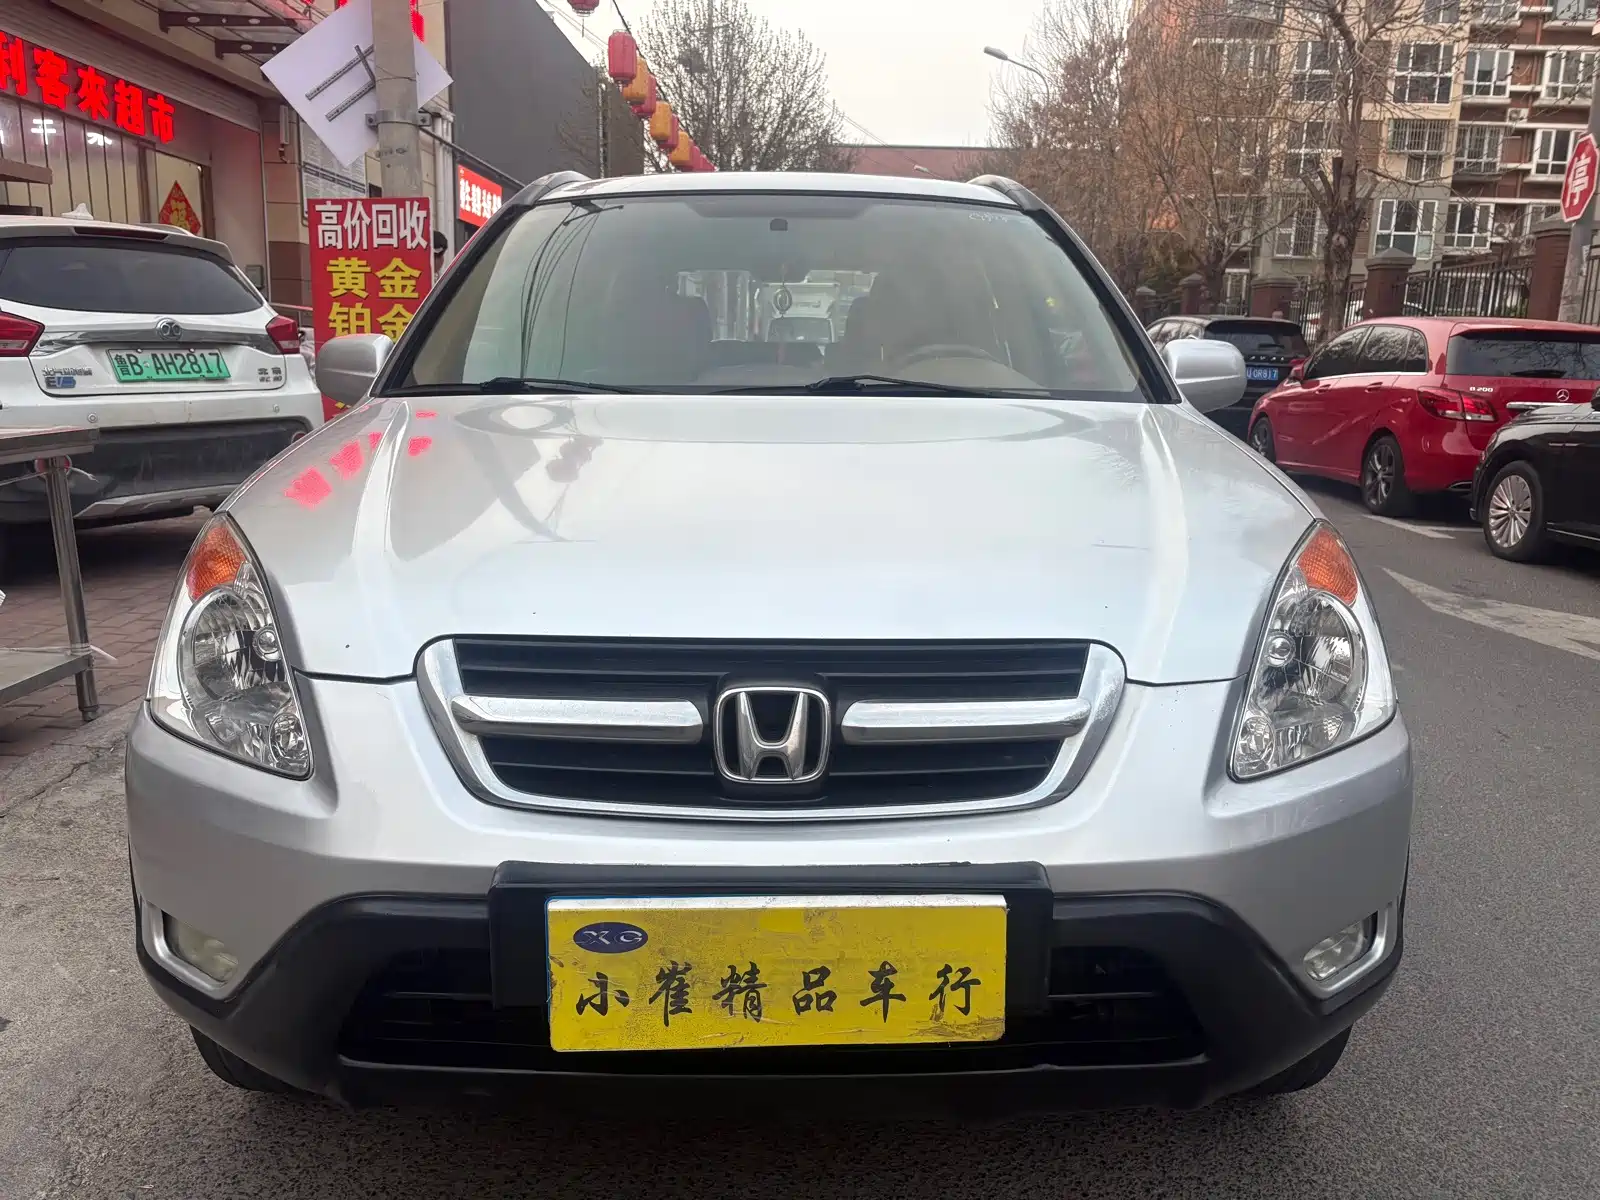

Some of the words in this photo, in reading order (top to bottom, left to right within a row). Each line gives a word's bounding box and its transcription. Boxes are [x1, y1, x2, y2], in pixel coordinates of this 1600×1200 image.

[1565, 152, 1591, 209] 停
[315, 201, 427, 250] 高价回收
[327, 257, 421, 299] 黄金
[575, 960, 981, 1027] 小崔精品车行
